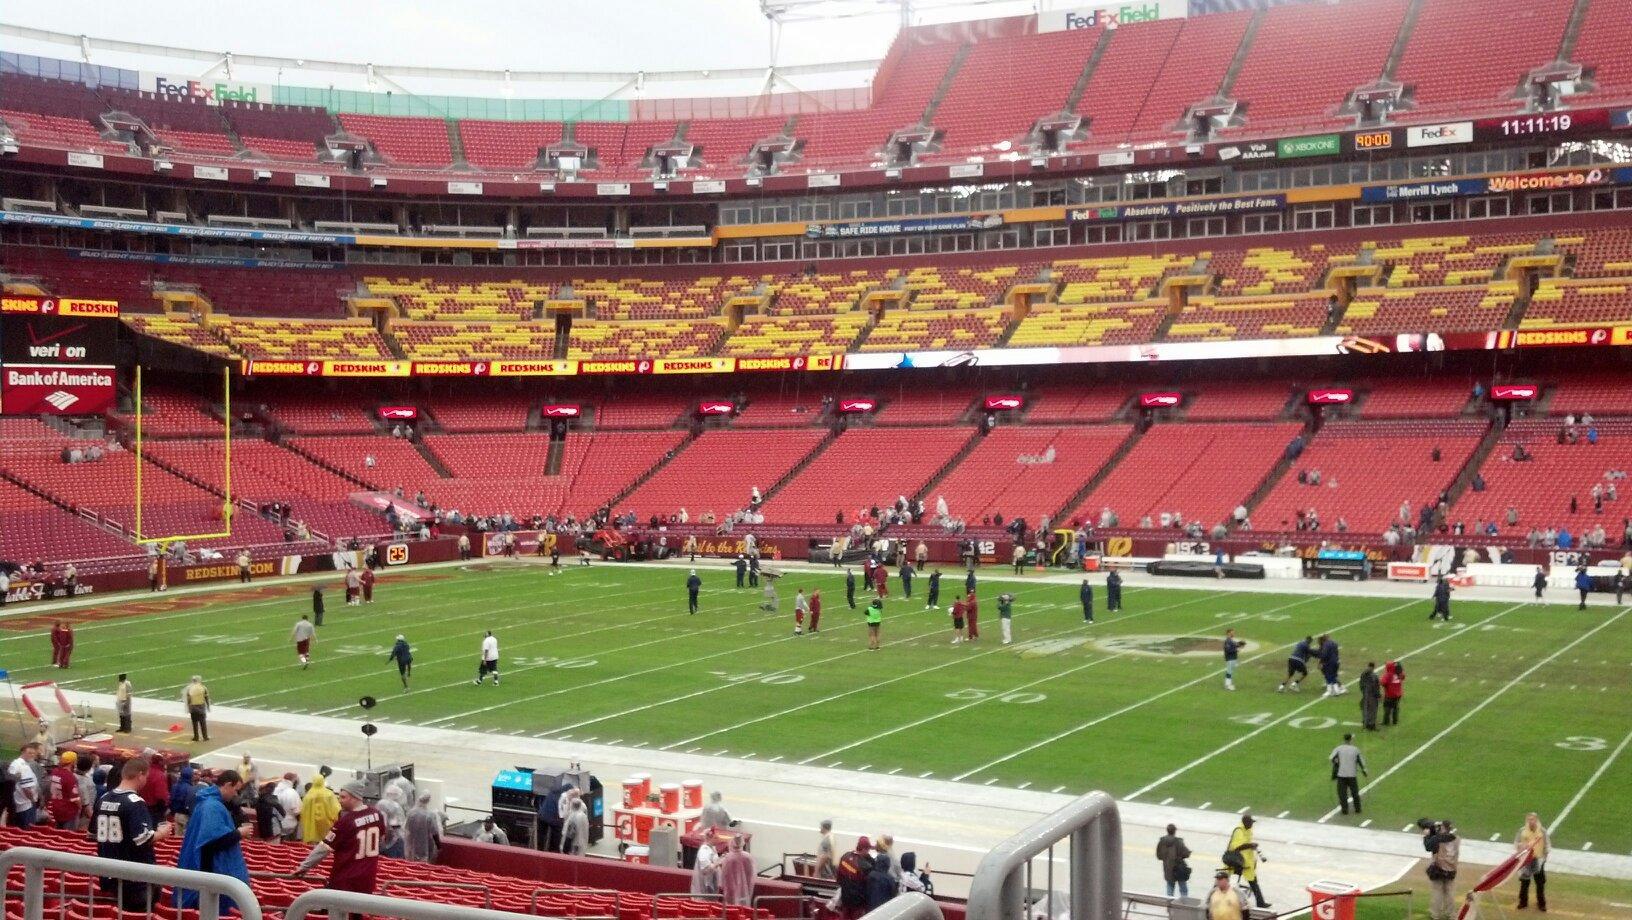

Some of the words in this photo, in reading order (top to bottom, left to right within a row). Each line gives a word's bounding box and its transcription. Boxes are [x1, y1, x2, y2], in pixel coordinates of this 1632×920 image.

[1502, 114, 1571, 136] 11:11:19
[1422, 127, 1457, 139] FedEx
[1356, 133, 1390, 147] 90:00
[1242, 151, 1276, 159] AAA.com
[1399, 185, 1430, 197] Merrill
[1431, 183, 1459, 196] Lynch
[1489, 176, 1563, 191] Welcome
[1176, 203, 1217, 215] Positively
[1219, 201, 1233, 210] the
[1234, 199, 1254, 209] Best
[1255, 198, 1278, 208] Fans.
[840, 227, 859, 236] SAFE
[860, 226, 878, 234] RIDE
[879, 224, 901, 233] HOME
[1517, 330, 1588, 345] REDSKINS
[252, 362, 304, 373] REDSKINS
[333, 363, 386, 373] REDSKINS
[416, 362, 471, 374] REDSKINS
[500, 363, 554, 373] REDSKINS
[582, 361, 636, 373] REDSKINS
[663, 361, 713, 371] REDSKINS
[738, 358, 791, 370] REDSKINS
[9, 371, 43, 386] Bank
[44, 371, 59, 386] of
[59, 372, 112, 386] America
[706, 541, 715, 552] to
[717, 540, 733, 553] the
[390, 546, 406, 561] 25
[1227, 711, 1338, 730] 40
[97, 814, 124, 843] 88
[355, 826, 380, 860] 10
